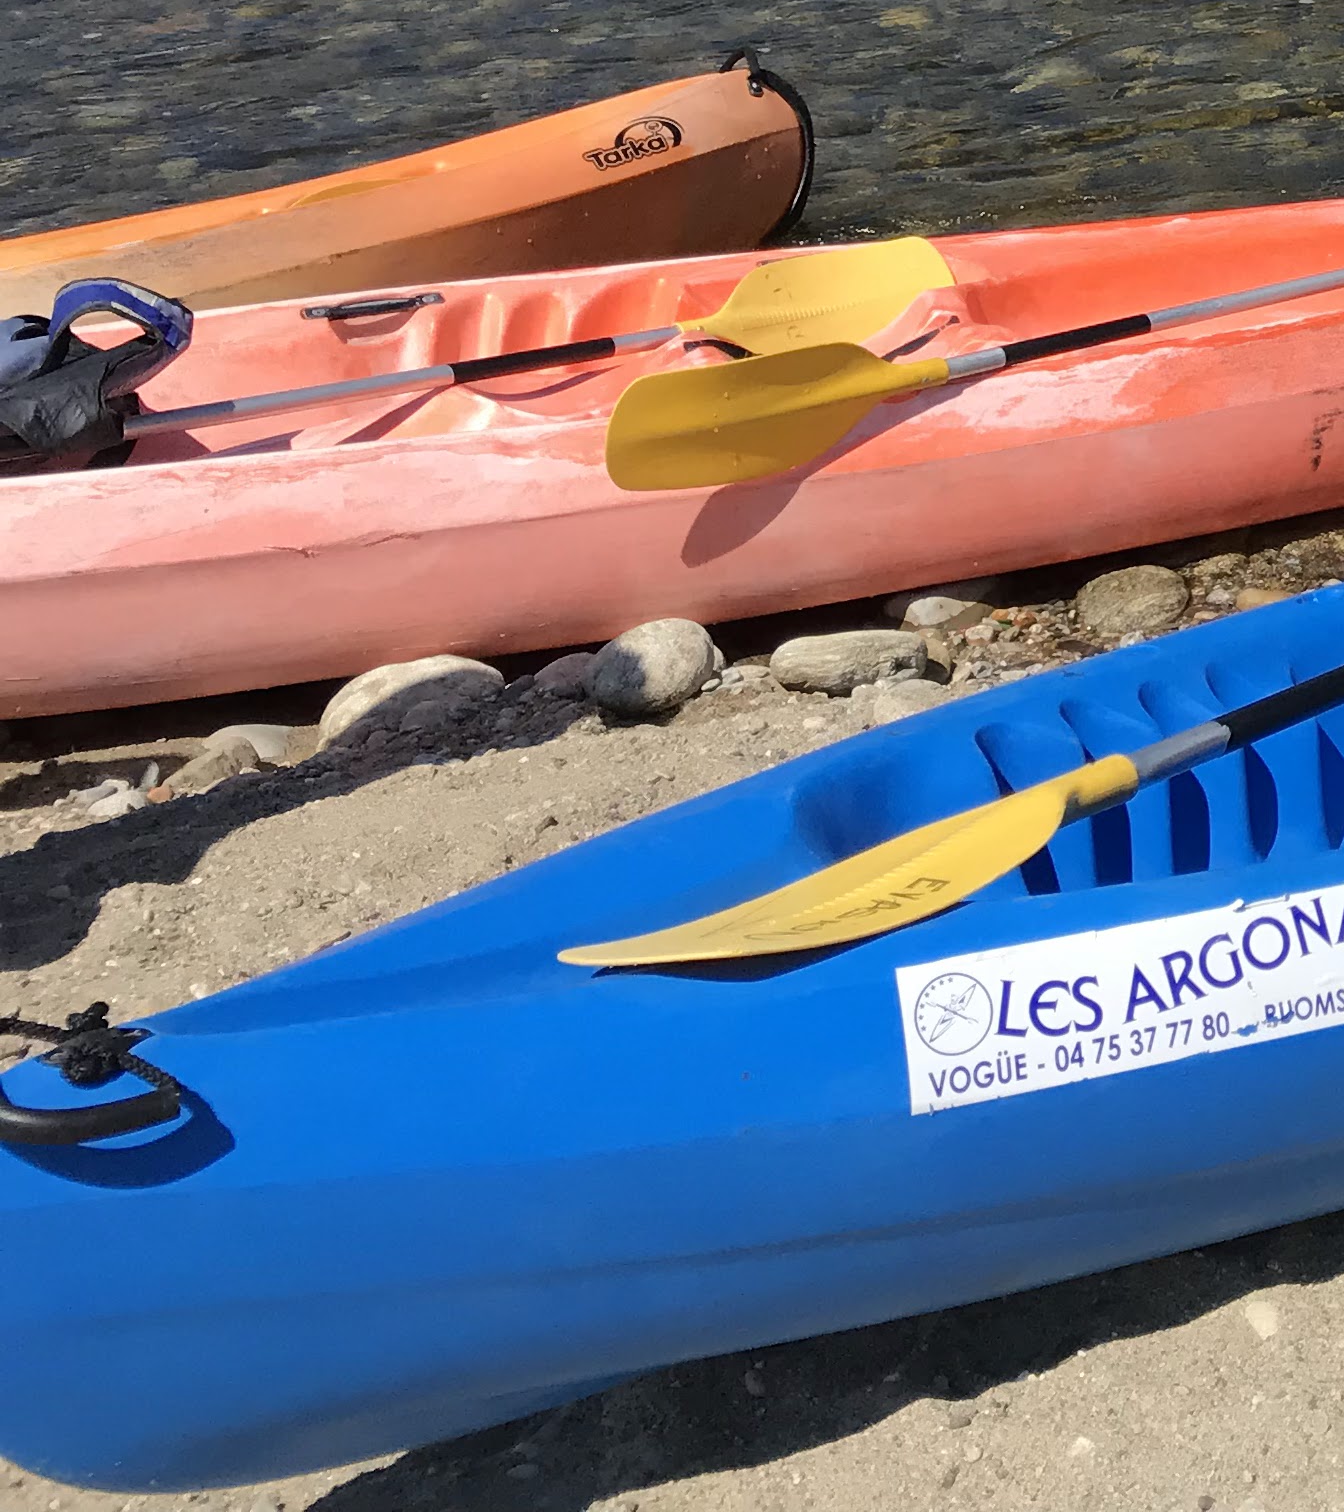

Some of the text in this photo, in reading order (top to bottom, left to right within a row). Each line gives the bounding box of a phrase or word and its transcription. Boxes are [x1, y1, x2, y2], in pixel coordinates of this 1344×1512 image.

[584, 136, 668, 170] Tarka
[995, 976, 1103, 1037] LES
[929, 1050, 1028, 1097] VOGÜE
[1055, 1041, 1085, 1072] 04
[1092, 1034, 1121, 1064] 75
[1130, 1027, 1157, 1057] 37
[1166, 1019, 1193, 1049] 77
[1202, 1011, 1230, 1041] 80
